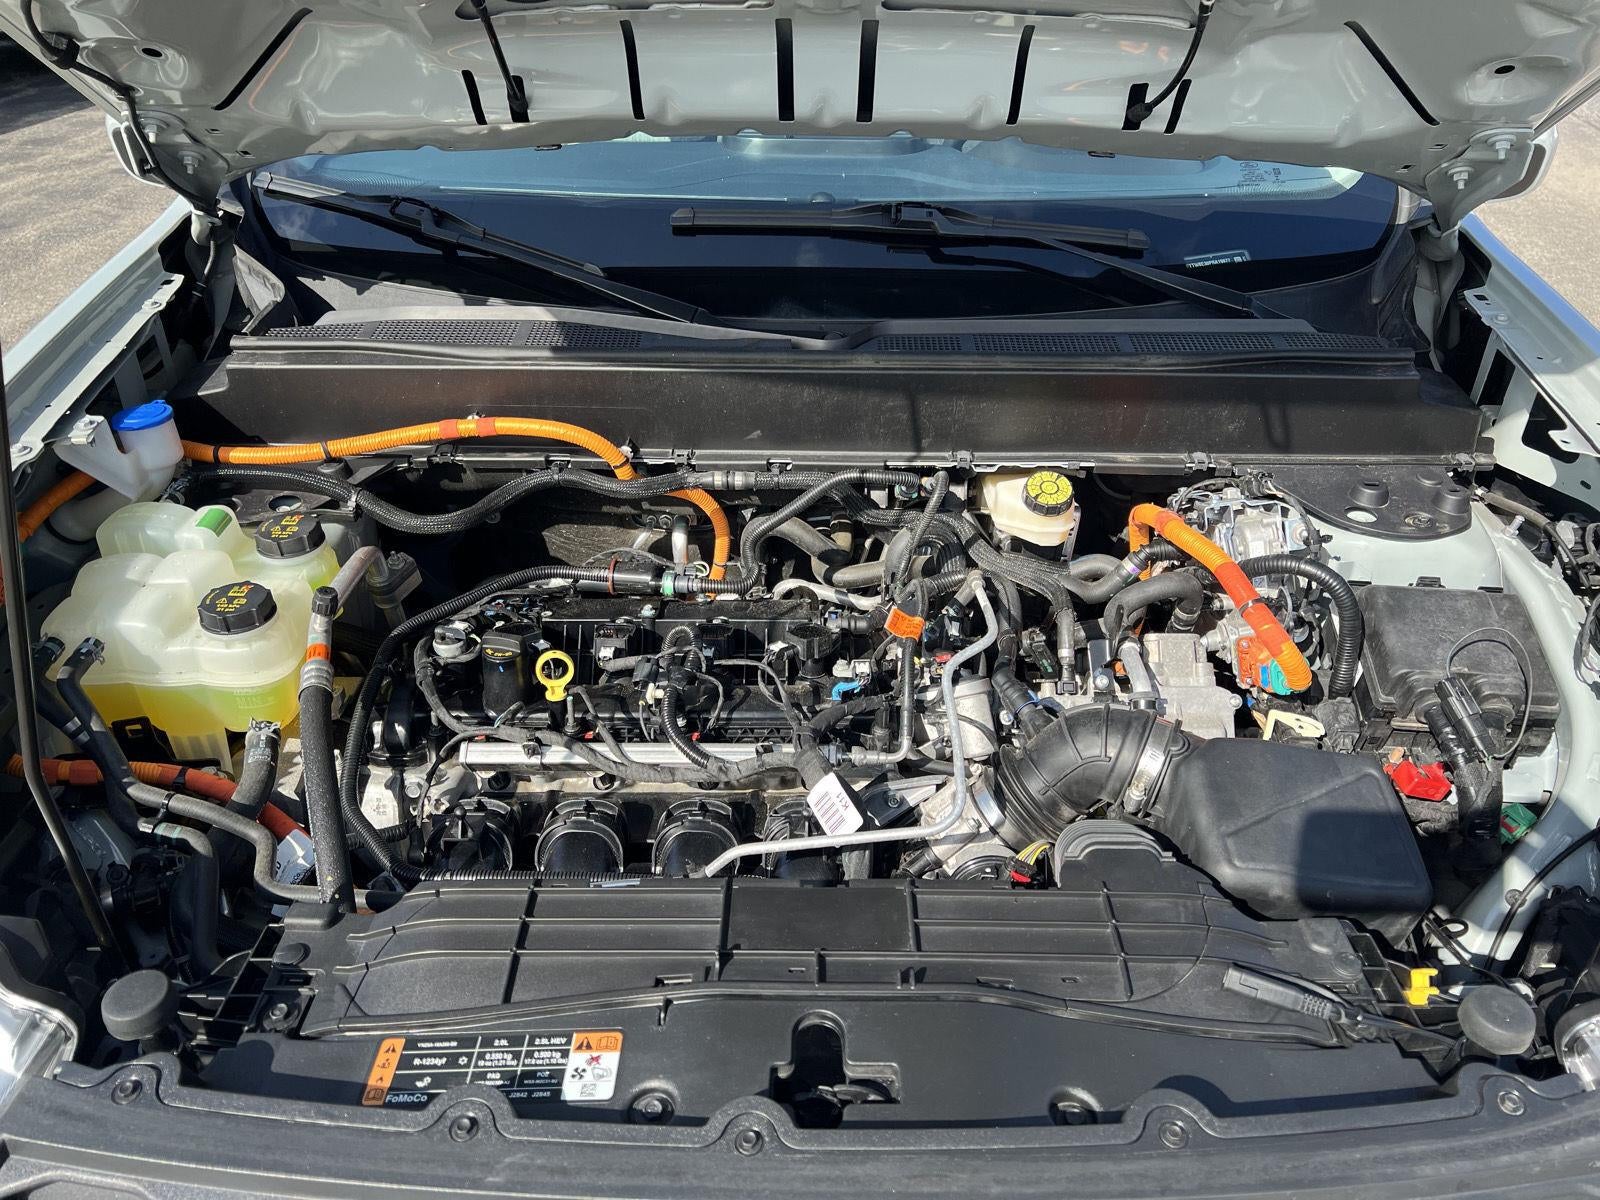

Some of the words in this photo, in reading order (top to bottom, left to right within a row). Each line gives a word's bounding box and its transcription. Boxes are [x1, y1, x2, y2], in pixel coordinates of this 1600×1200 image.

[550, 1037, 568, 1045] HEV
[503, 1052, 513, 1061] kg
[552, 1050, 562, 1059] kg
[413, 1056, 447, 1066] R-1234yf
[385, 1093, 428, 1103] FoMoCo
